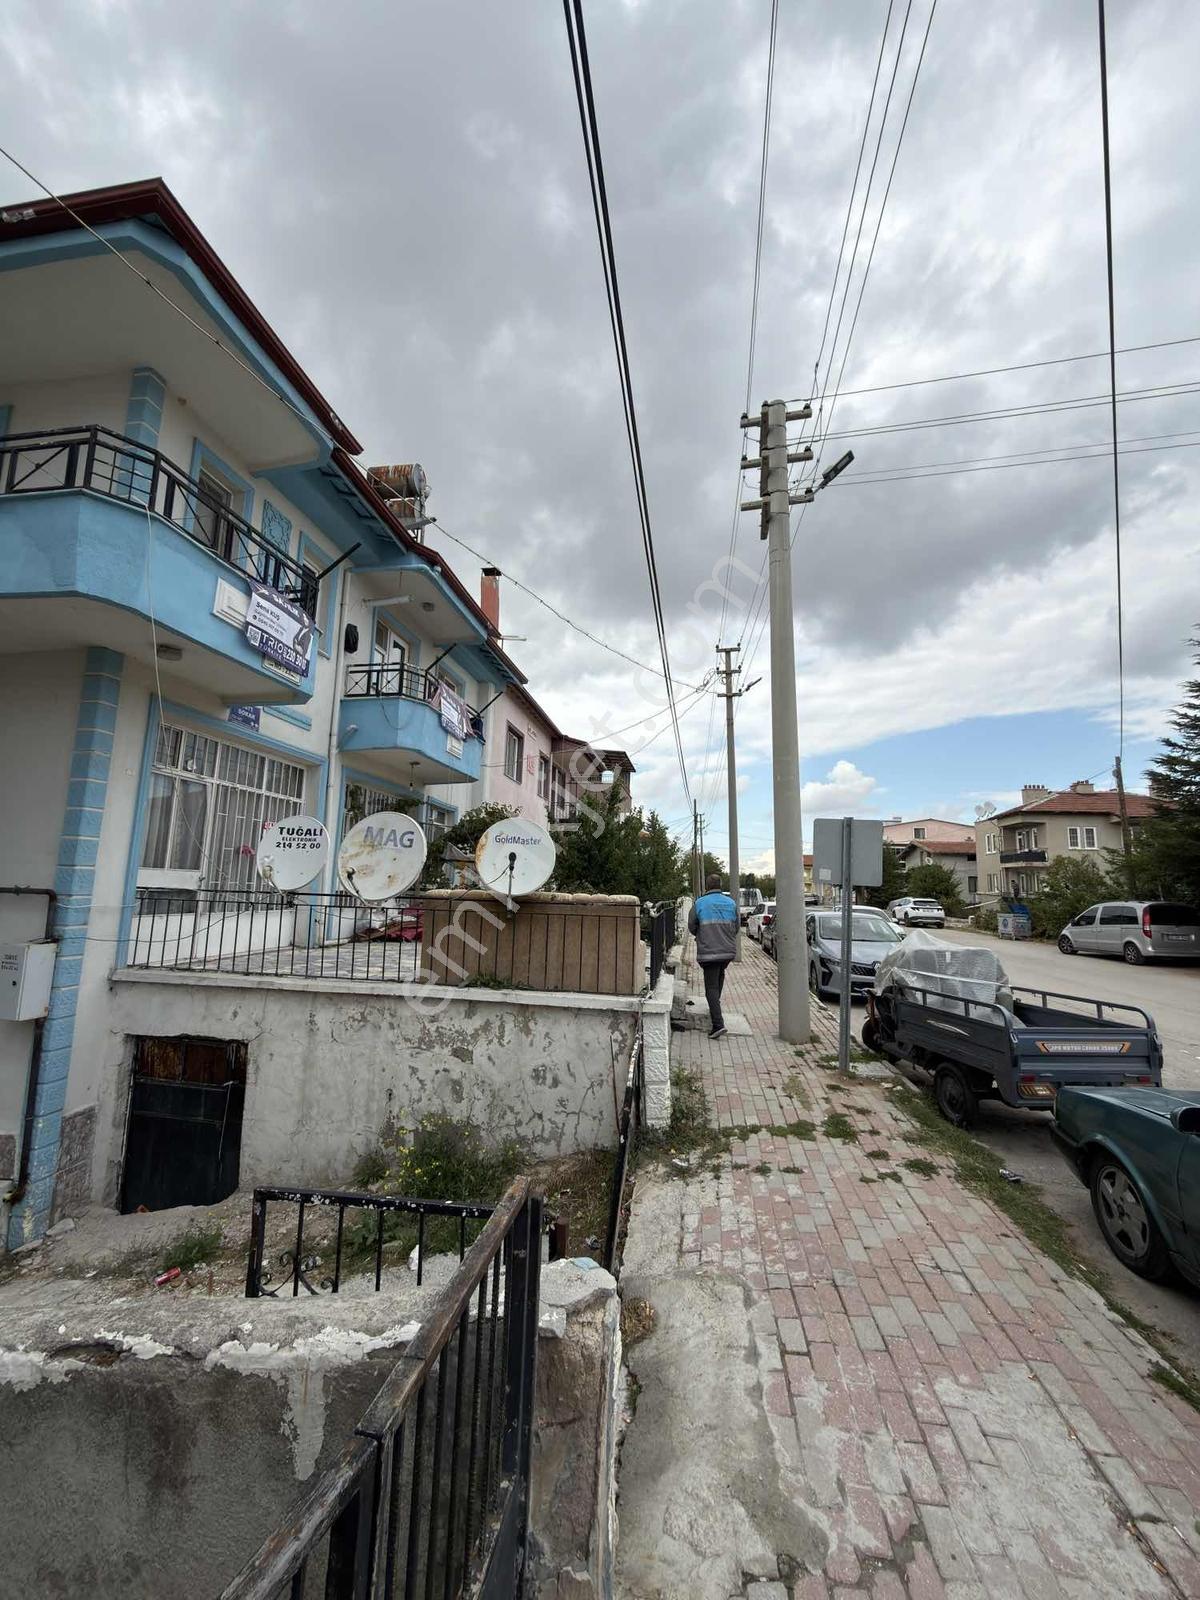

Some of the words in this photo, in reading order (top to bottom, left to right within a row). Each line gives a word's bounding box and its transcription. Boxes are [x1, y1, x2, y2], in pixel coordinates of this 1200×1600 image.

[261, 633, 284, 653] TRIO
[363, 826, 415, 849] MAG
[494, 834, 542, 846] GoldMaster
[295, 842, 307, 850] 52
[309, 842, 321, 850] 00
